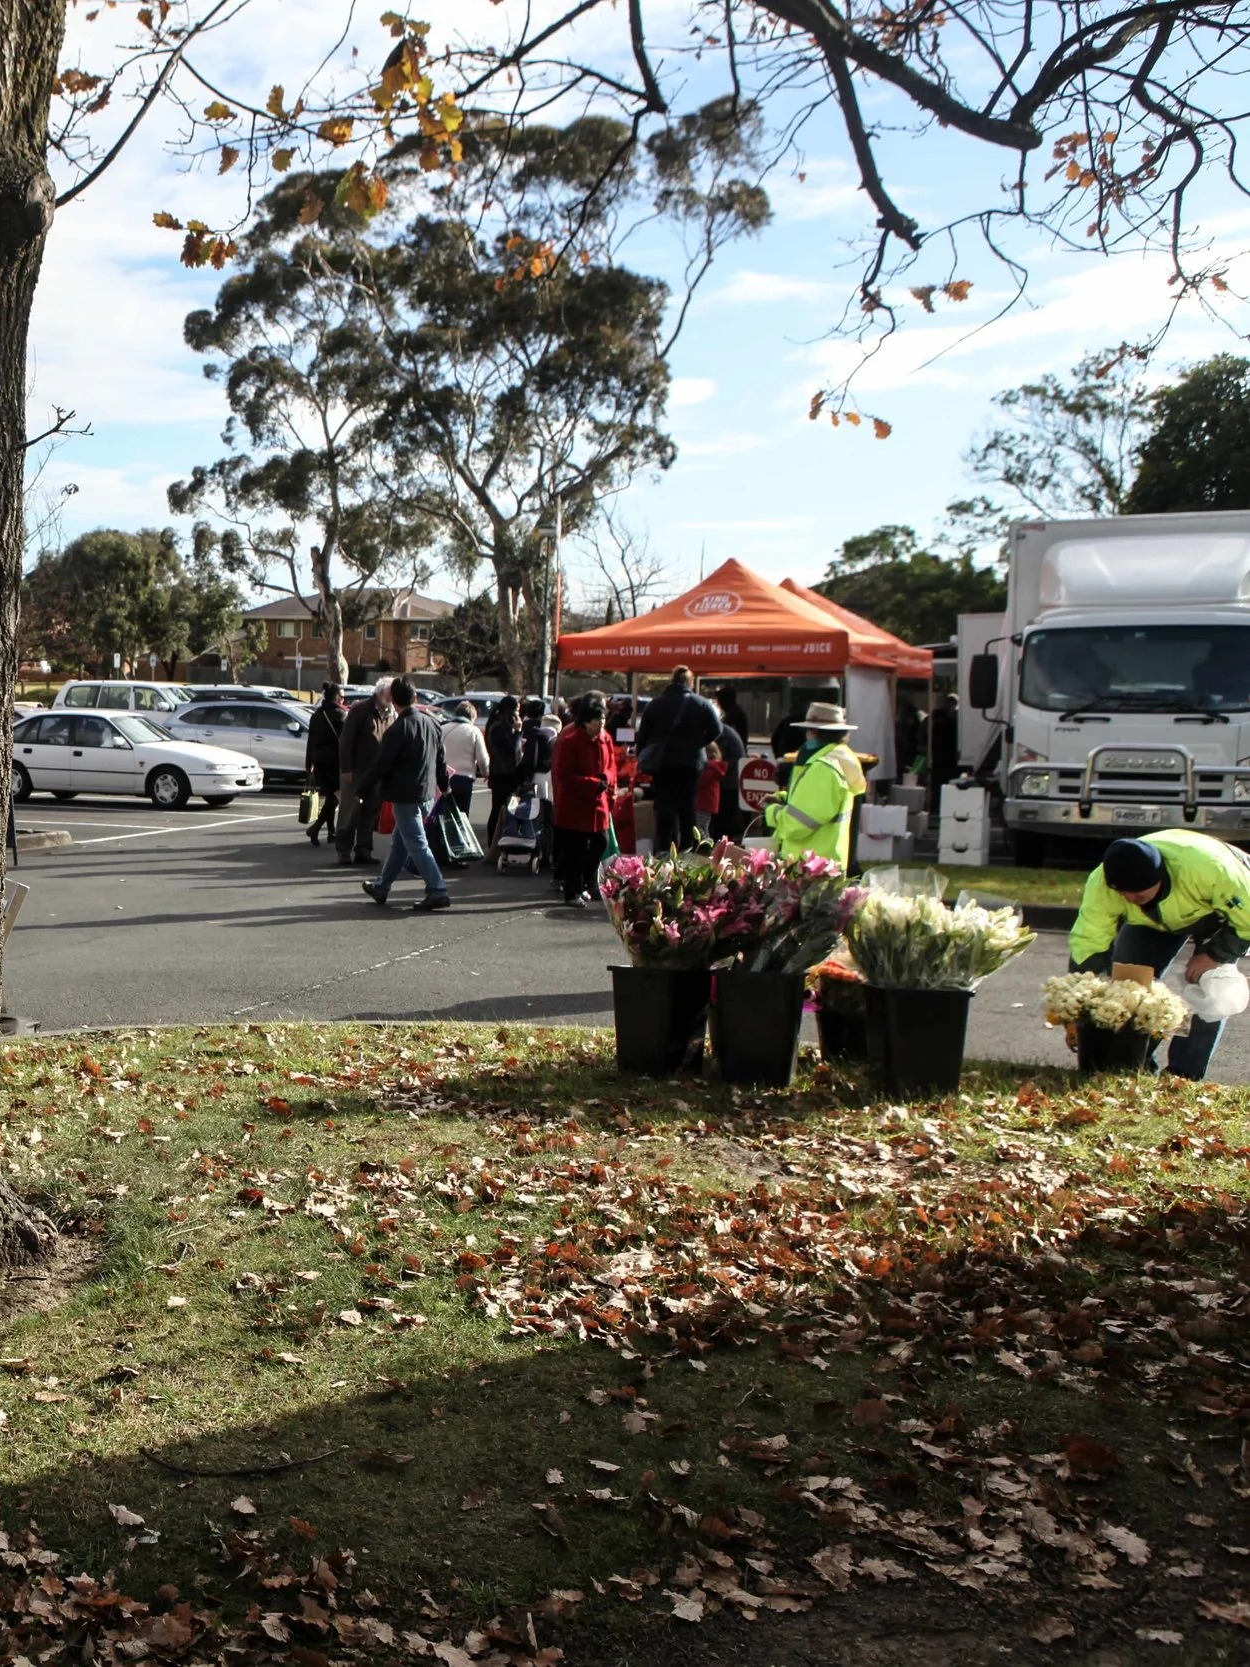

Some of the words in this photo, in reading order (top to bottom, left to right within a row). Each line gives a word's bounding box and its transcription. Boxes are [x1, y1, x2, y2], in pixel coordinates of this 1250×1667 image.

[619, 646, 650, 656] CITRUS
[692, 644, 706, 655] ICY
[711, 643, 738, 654] POLES
[803, 642, 832, 654] JUICE
[754, 768, 768, 778] NO
